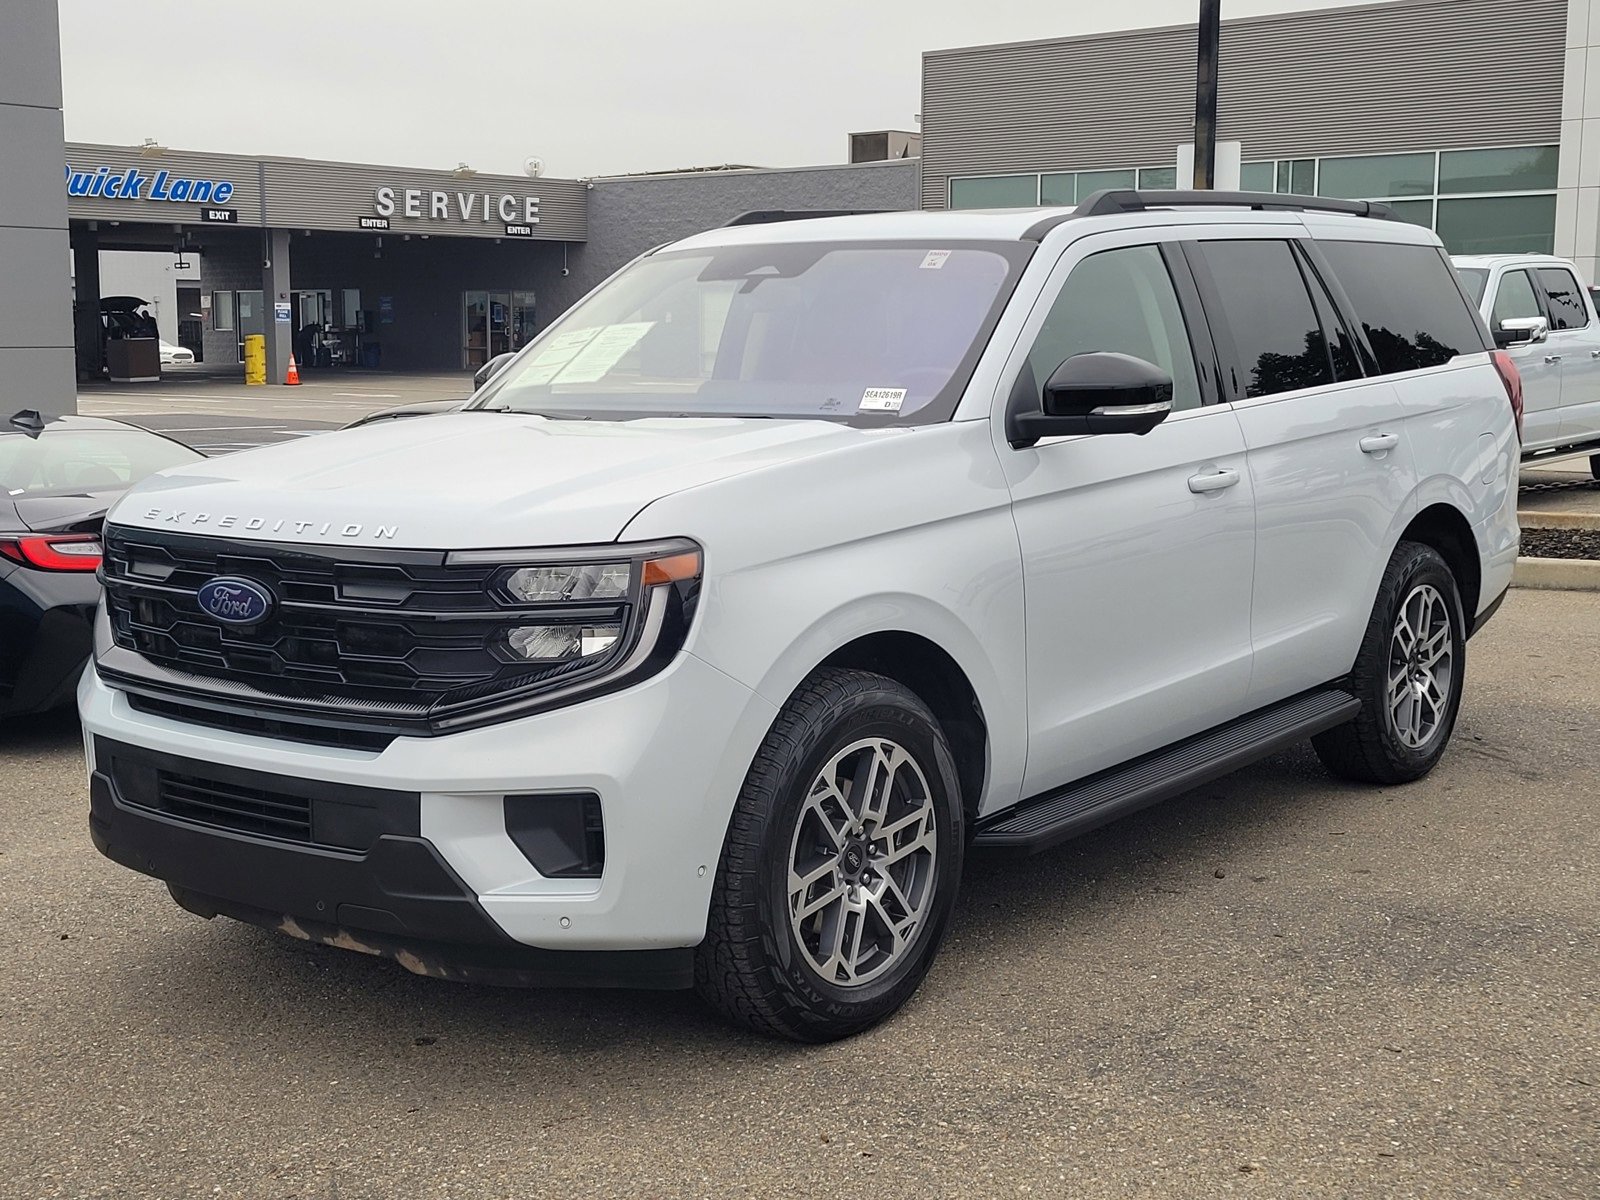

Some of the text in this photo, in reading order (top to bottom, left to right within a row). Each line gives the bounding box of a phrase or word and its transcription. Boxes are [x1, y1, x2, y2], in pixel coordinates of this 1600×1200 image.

[66, 164, 234, 204] uick Lane
[209, 210, 230, 220] EXIT
[375, 187, 540, 223] SERVICE
[361, 218, 388, 229] ENTER
[507, 226, 531, 235] ENTER
[143, 507, 399, 540] EXPEDITION
[210, 586, 252, 617] Ford
